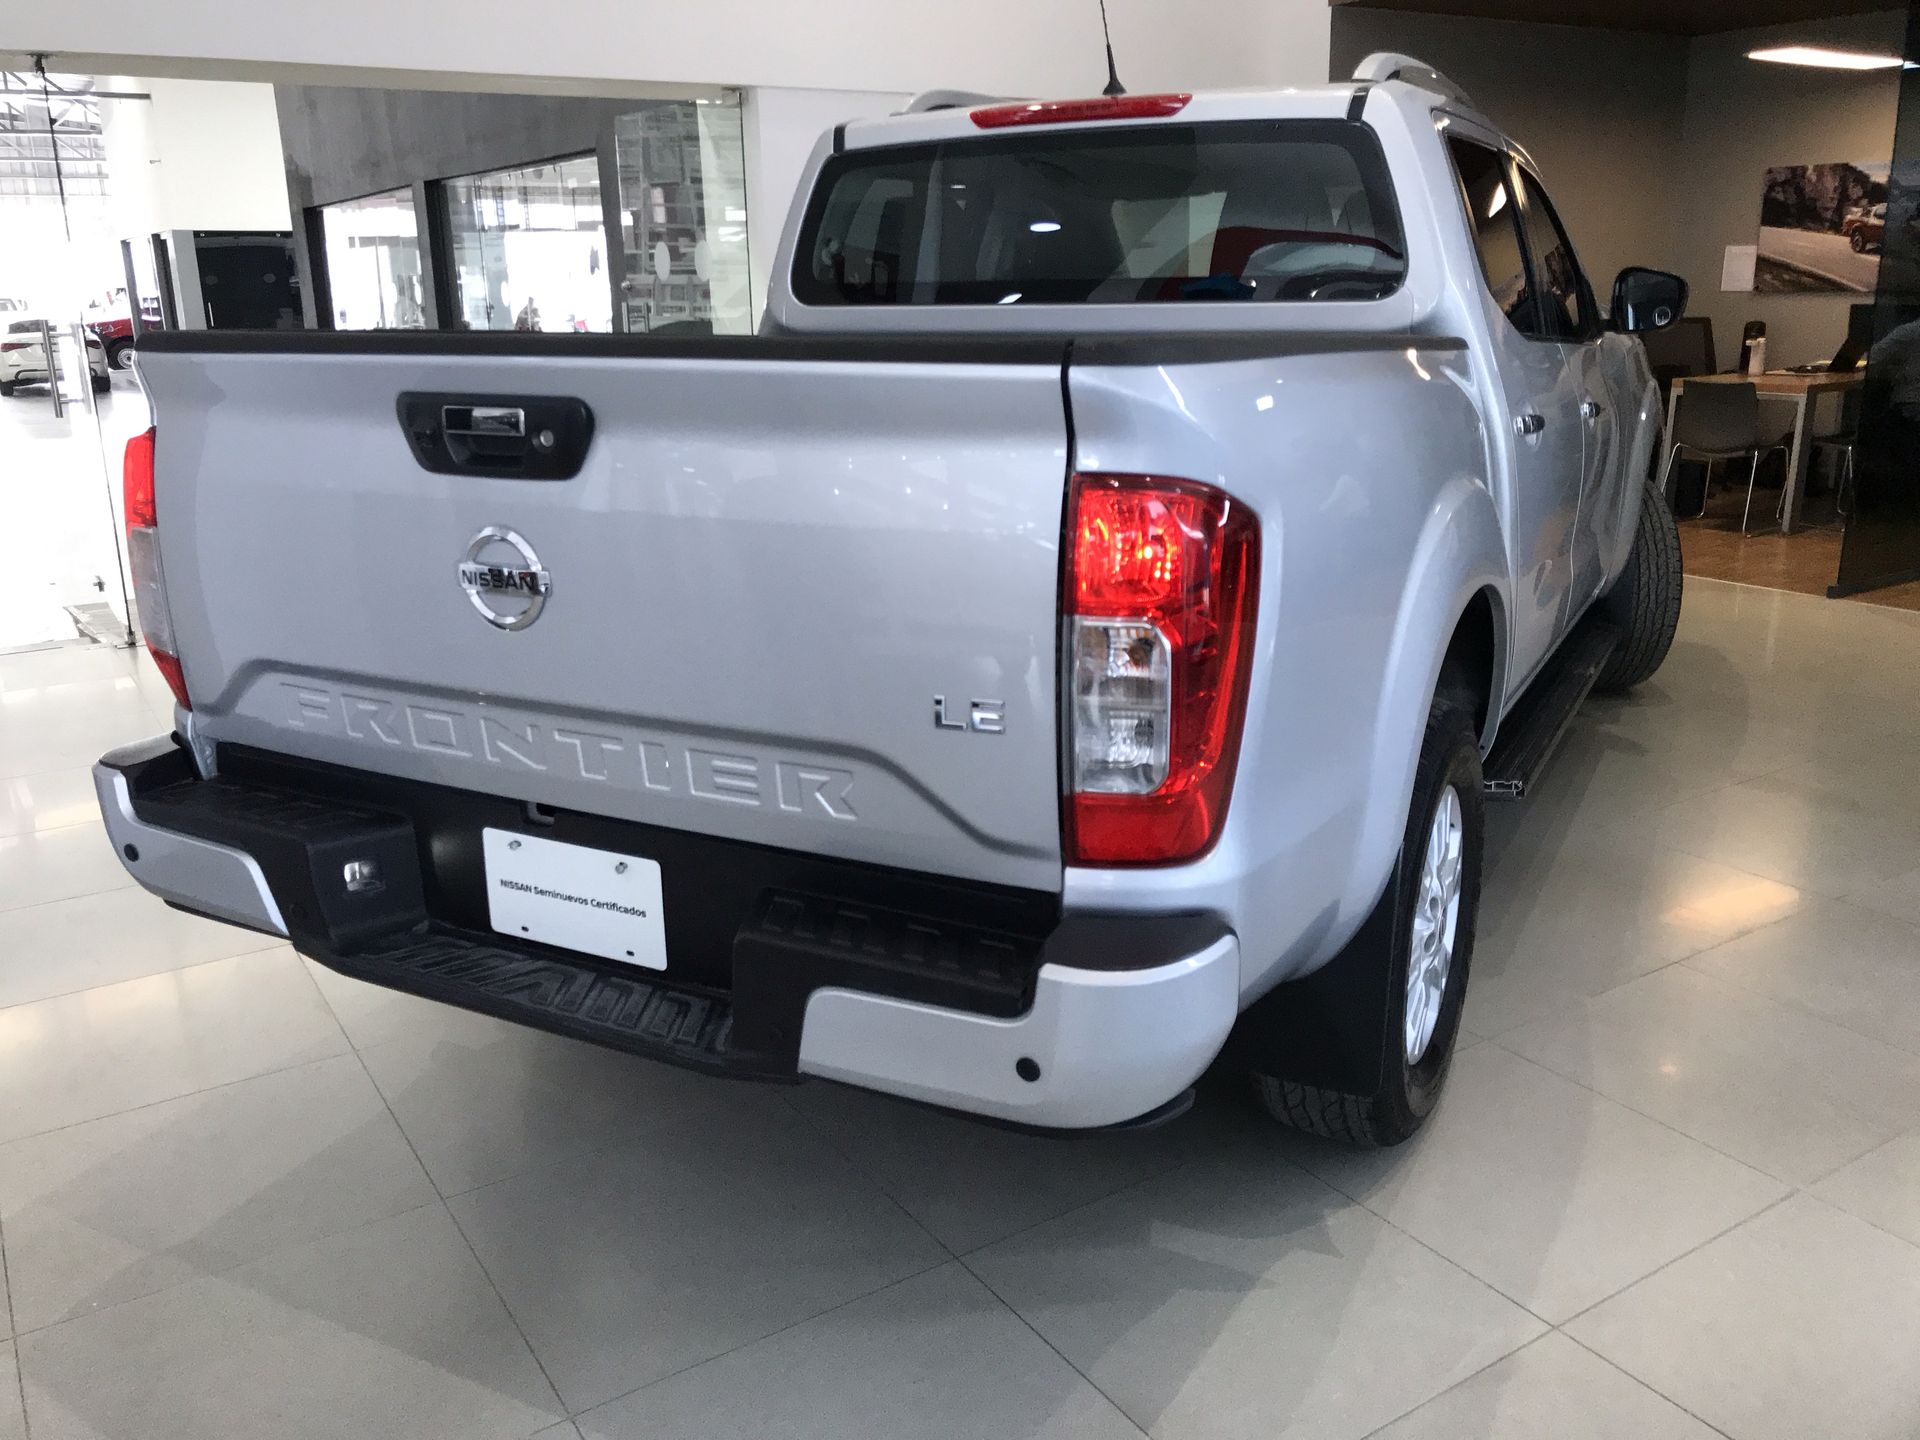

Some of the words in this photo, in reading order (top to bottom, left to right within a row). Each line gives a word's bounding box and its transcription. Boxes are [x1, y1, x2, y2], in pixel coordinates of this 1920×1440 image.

[461, 568, 539, 595] NISSAN
[933, 694, 1006, 735] LE
[279, 682, 857, 821] FRONTIER
[500, 878, 533, 894] NISSAN
[533, 886, 589, 906] Seminuevos
[590, 899, 647, 918] Certificados
